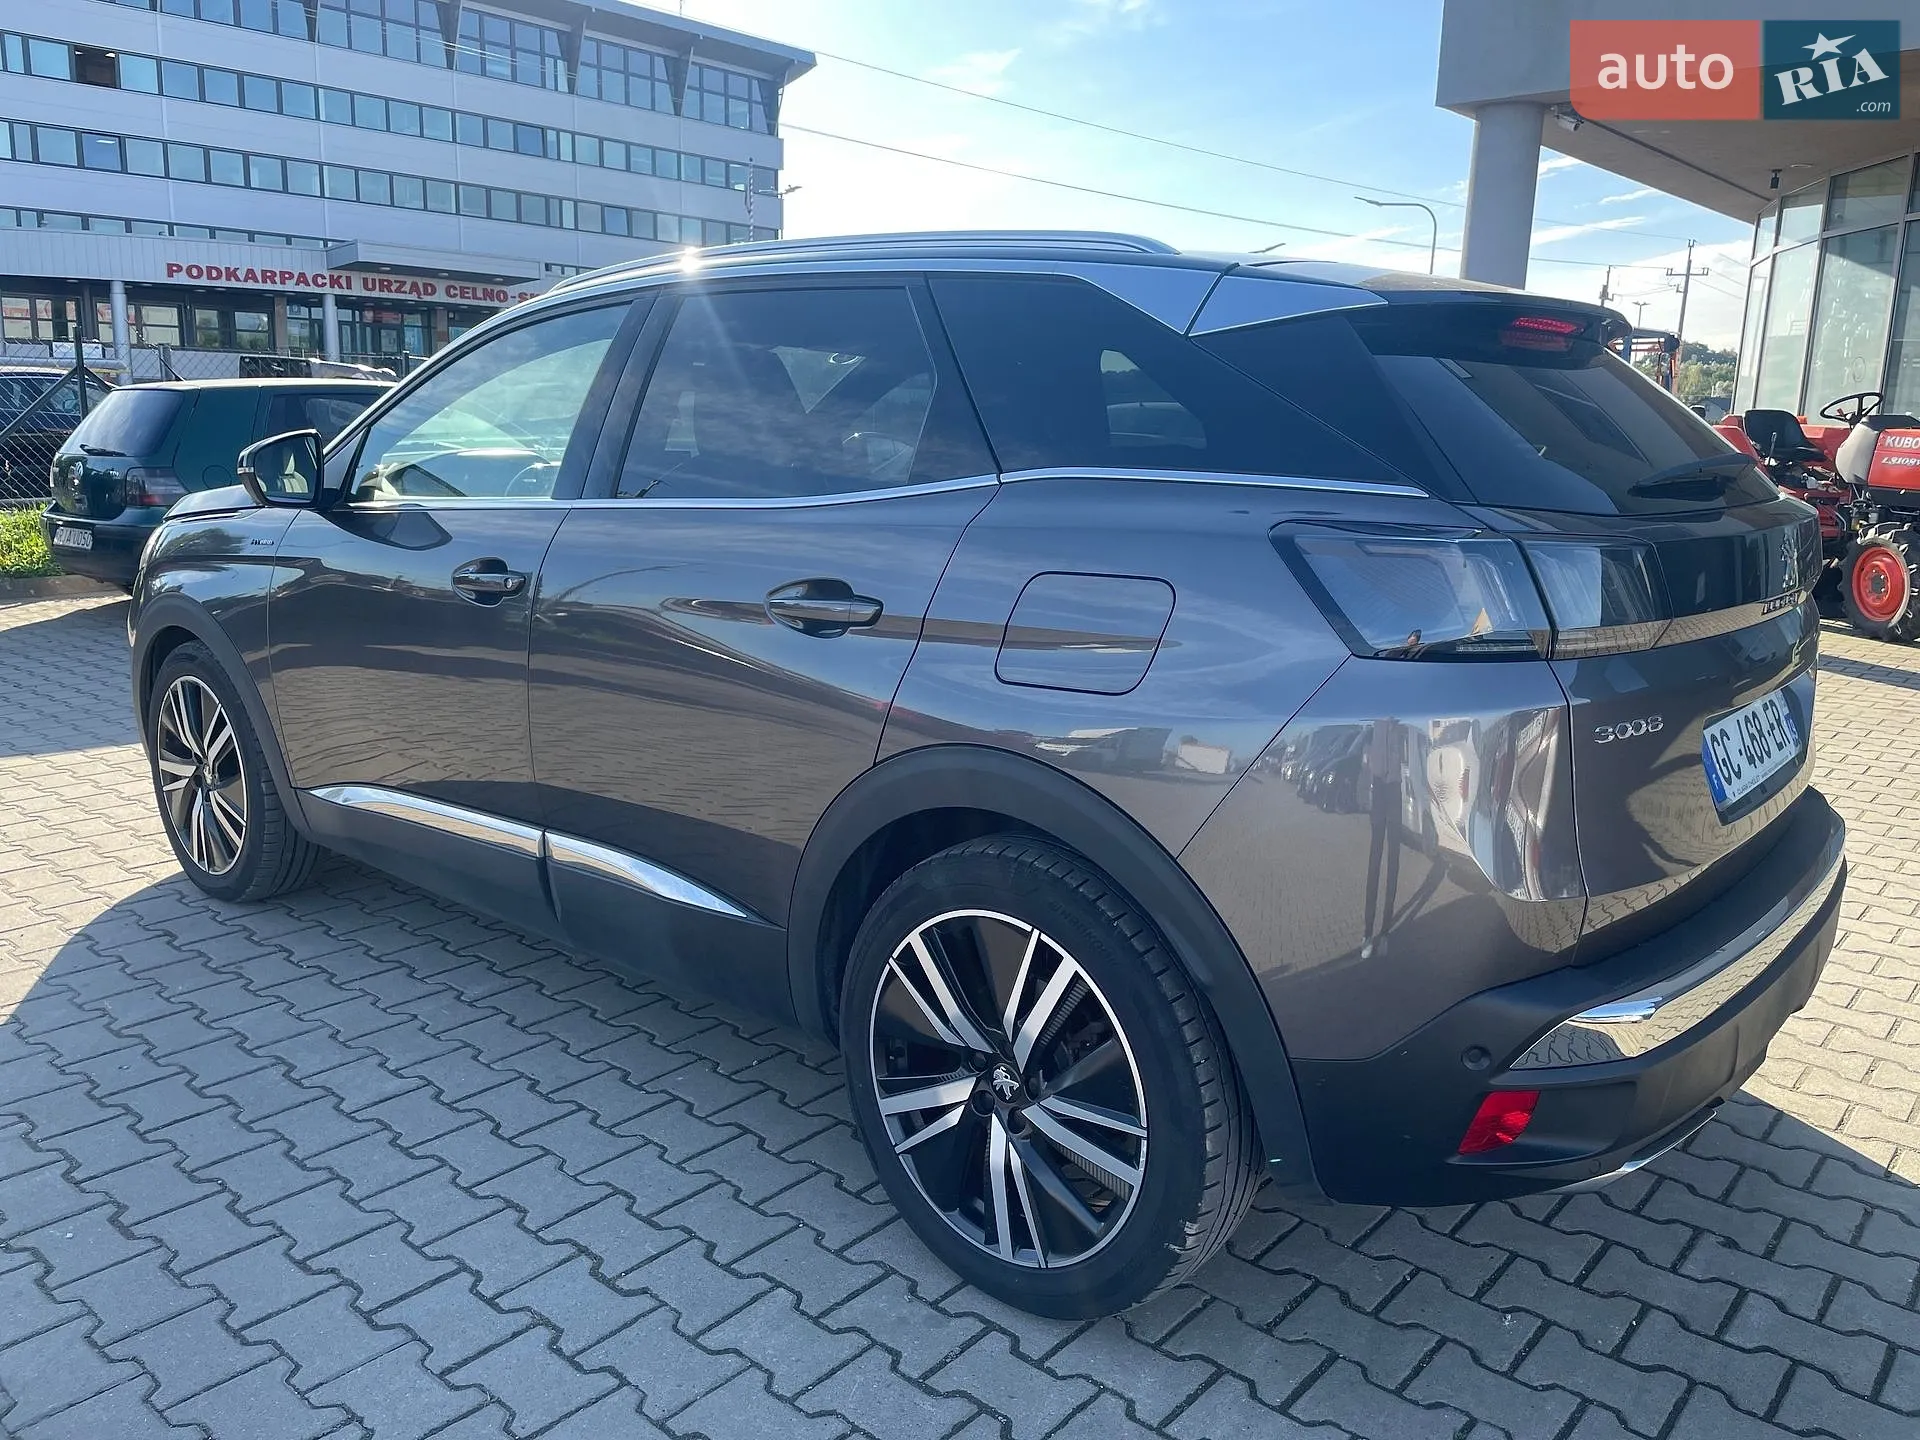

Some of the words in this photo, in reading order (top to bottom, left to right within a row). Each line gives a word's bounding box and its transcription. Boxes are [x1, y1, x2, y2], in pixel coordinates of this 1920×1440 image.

[167, 263, 352, 290] PODKARPACKI
[363, 277, 437, 299] URZĄD
[1885, 435, 1920, 449] KUBO
[1594, 716, 1664, 744] 3008
